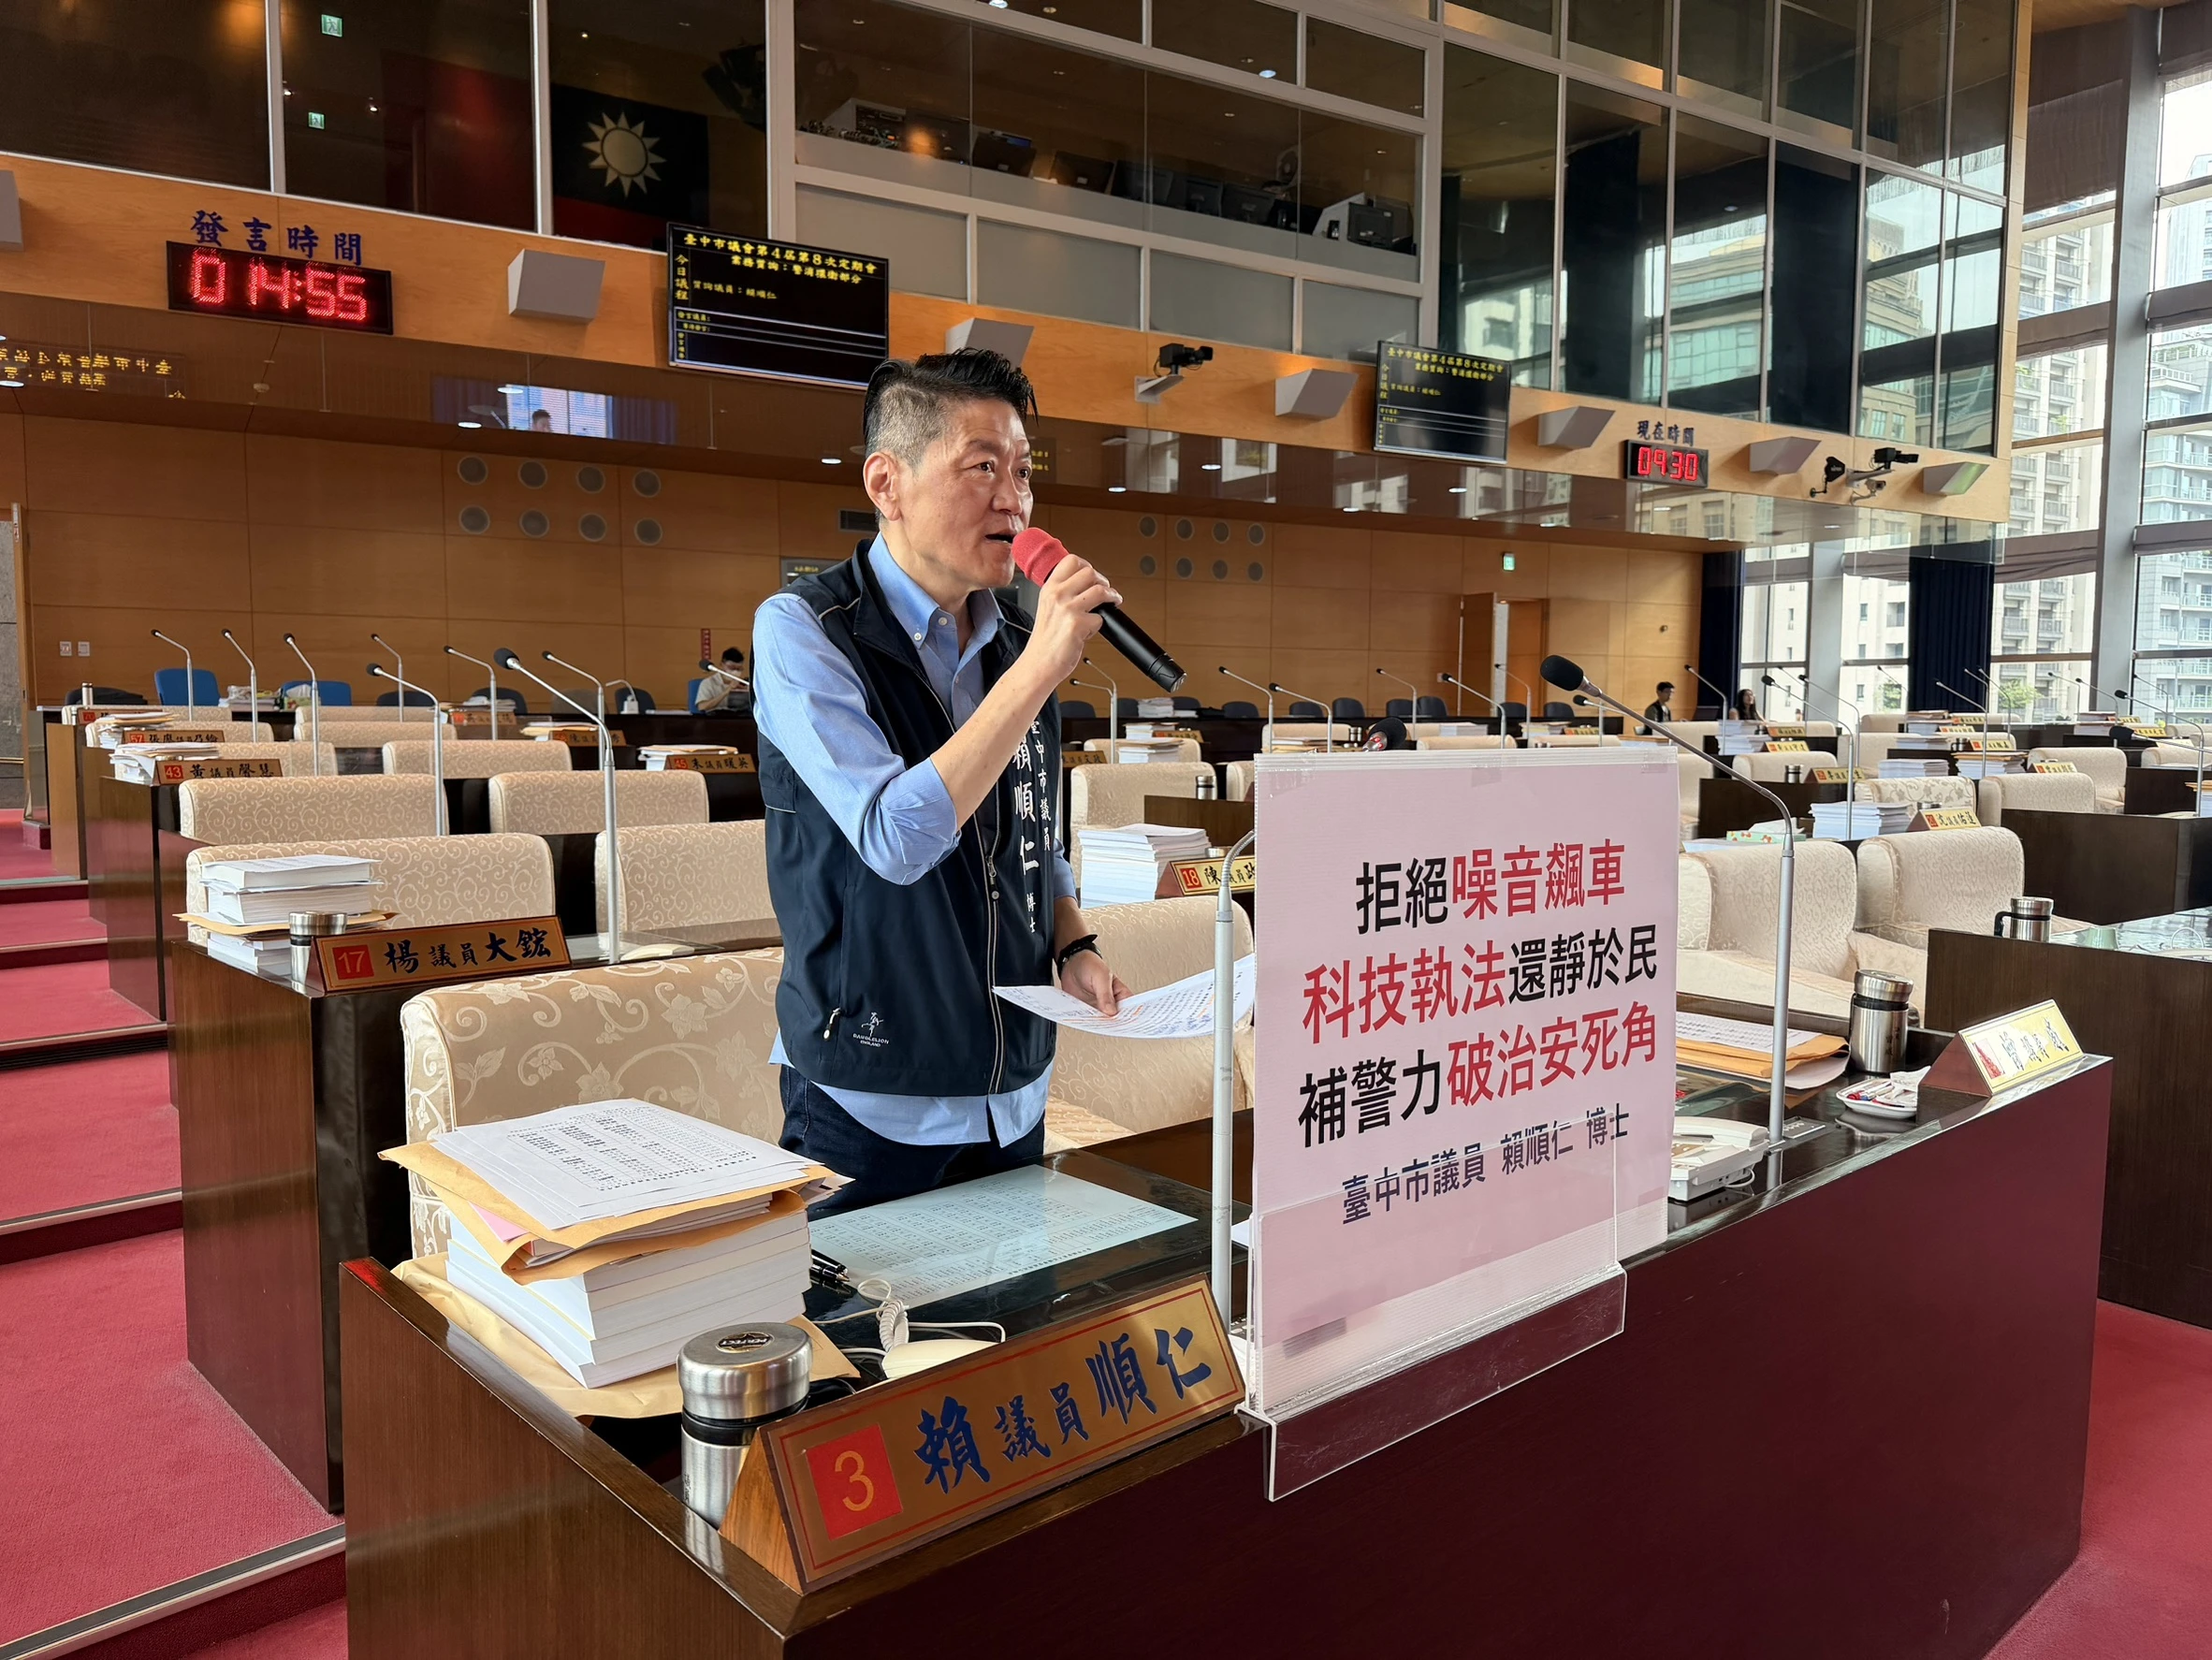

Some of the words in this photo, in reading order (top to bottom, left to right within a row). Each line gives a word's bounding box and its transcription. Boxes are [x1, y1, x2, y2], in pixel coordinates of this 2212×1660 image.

[191, 211, 361, 266] 發言時間
[684, 233, 877, 274] 臺中市議會第4屆第8次定期會
[249, 260, 367, 321] 14:55
[675, 254, 689, 300] 今日議程
[1637, 420, 1695, 446] 現在時間
[165, 766, 182, 779] 43
[1183, 869, 1201, 886] 18
[1355, 838, 1625, 935] 拒絕噪音飆車
[1026, 892, 1037, 934] 博士
[338, 950, 367, 974] 17
[384, 927, 551, 974] 楊議員大鋐
[1302, 924, 1657, 1045] 科技執法還靜於民
[1298, 1001, 1656, 1148] 補警力破治安死角
[1342, 1142, 1487, 1225] 臺中市議員
[1500, 1119, 1574, 1175] 賴順仁
[1586, 1102, 1630, 1150] 博士
[834, 1449, 876, 1513] 3
[913, 1326, 1213, 1495] 賴議員順仁
